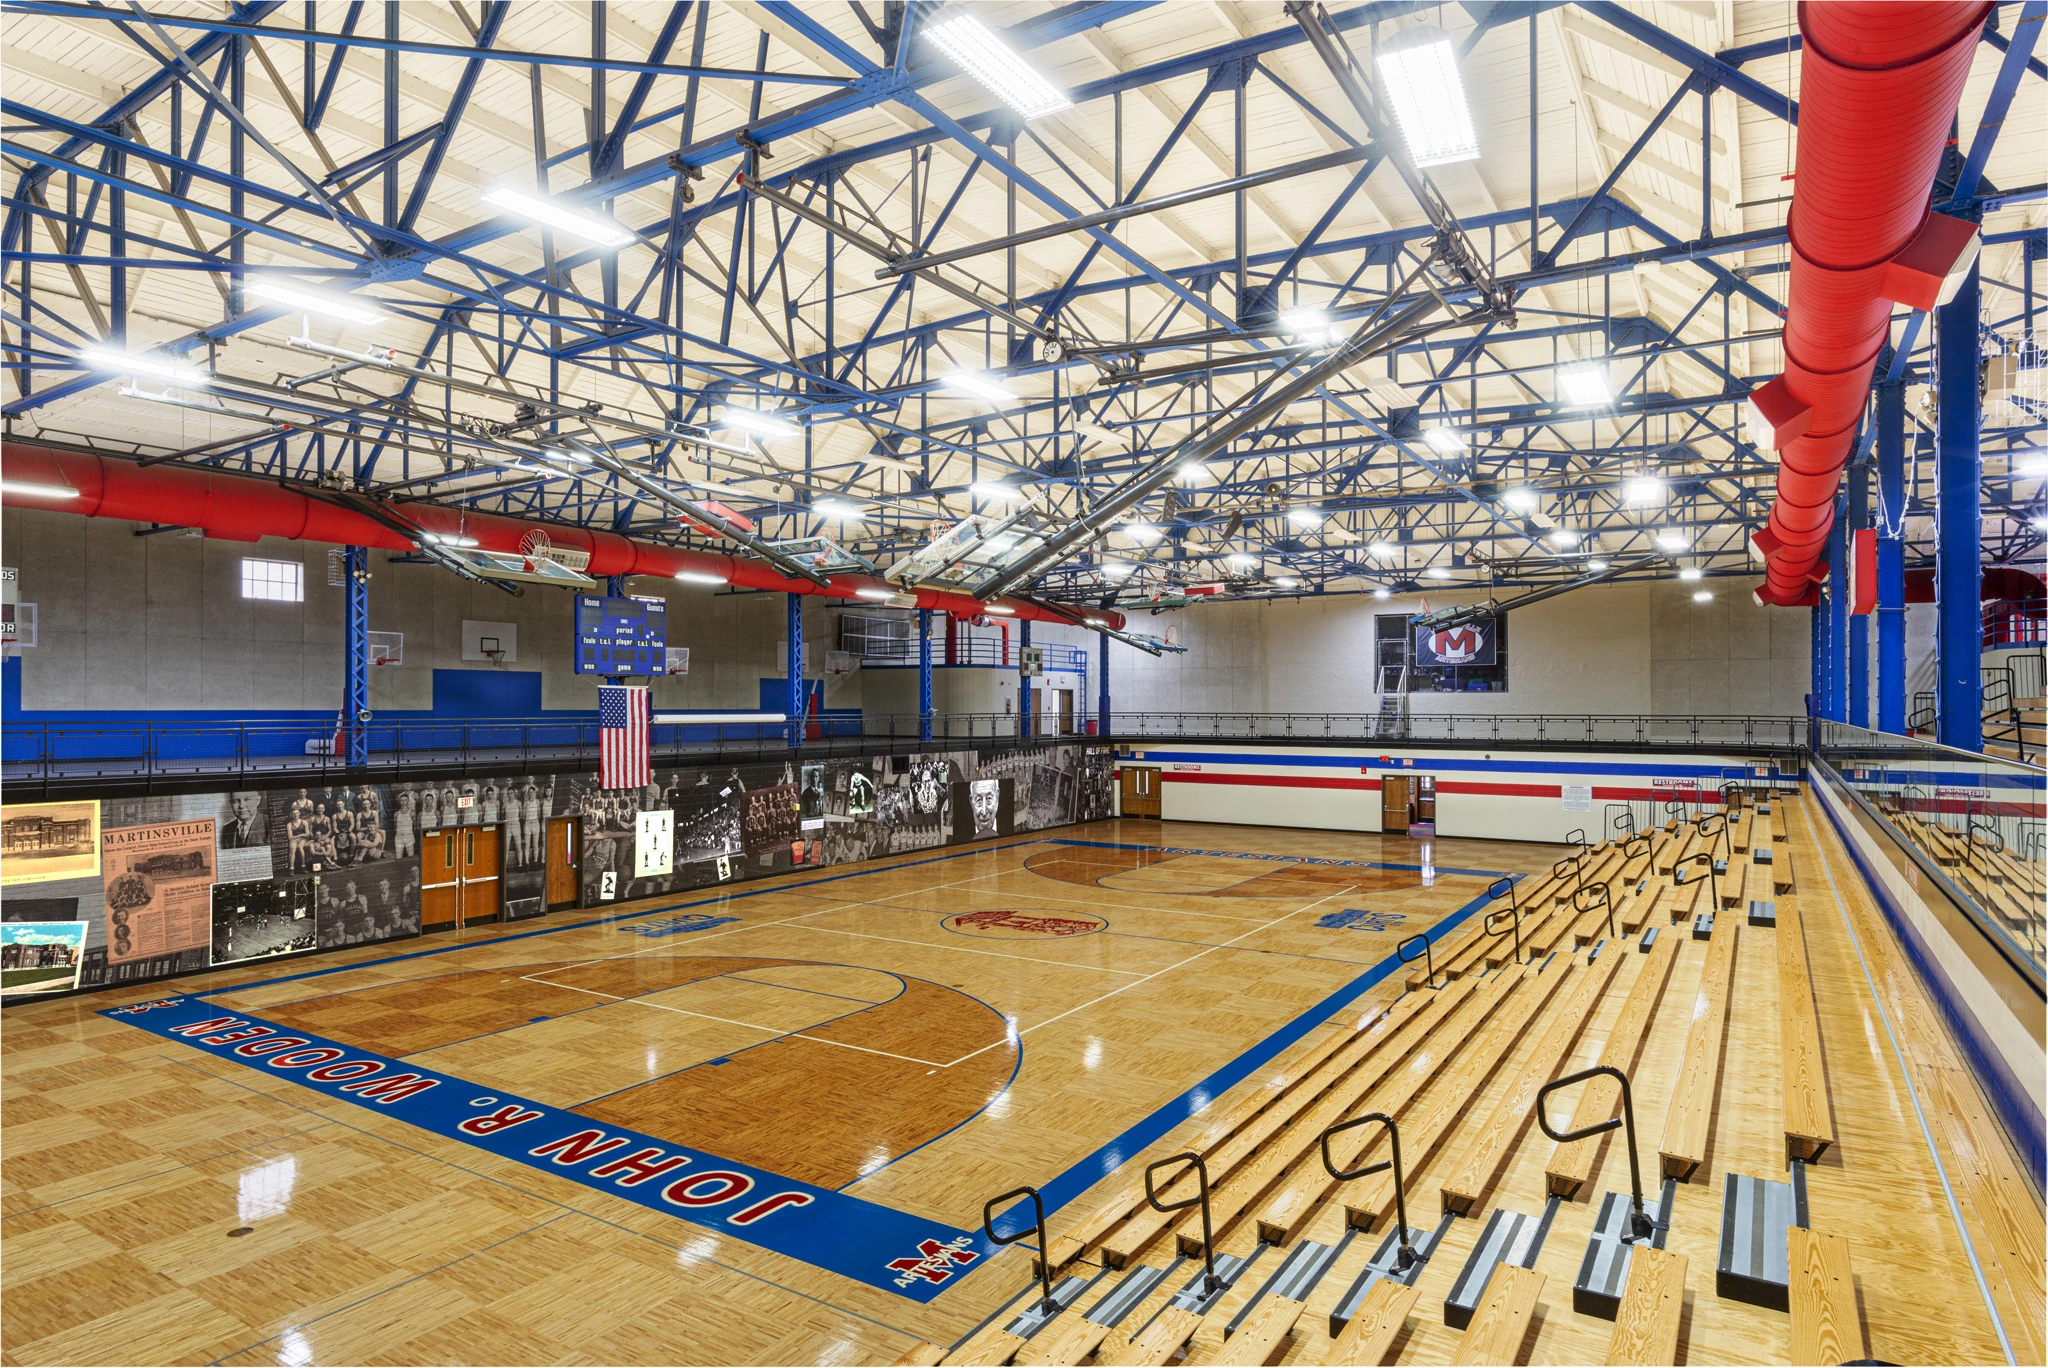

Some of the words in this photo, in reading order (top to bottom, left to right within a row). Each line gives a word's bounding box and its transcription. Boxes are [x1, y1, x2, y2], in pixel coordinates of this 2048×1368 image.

[584, 598, 600, 607] Home
[646, 603, 664, 613] Guests
[616, 627, 633, 635] period
[615, 638, 633, 646] player
[1435, 628, 1476, 656] M
[617, 664, 631, 672] game
[461, 798, 471, 806] EXIT
[104, 824, 212, 845] MARTINSVILLE
[169, 1016, 441, 1105] WOODEN
[529, 1130, 815, 1227] JOHN
[884, 1238, 981, 1285] M
[893, 1236, 974, 1288] ARTESIANS
